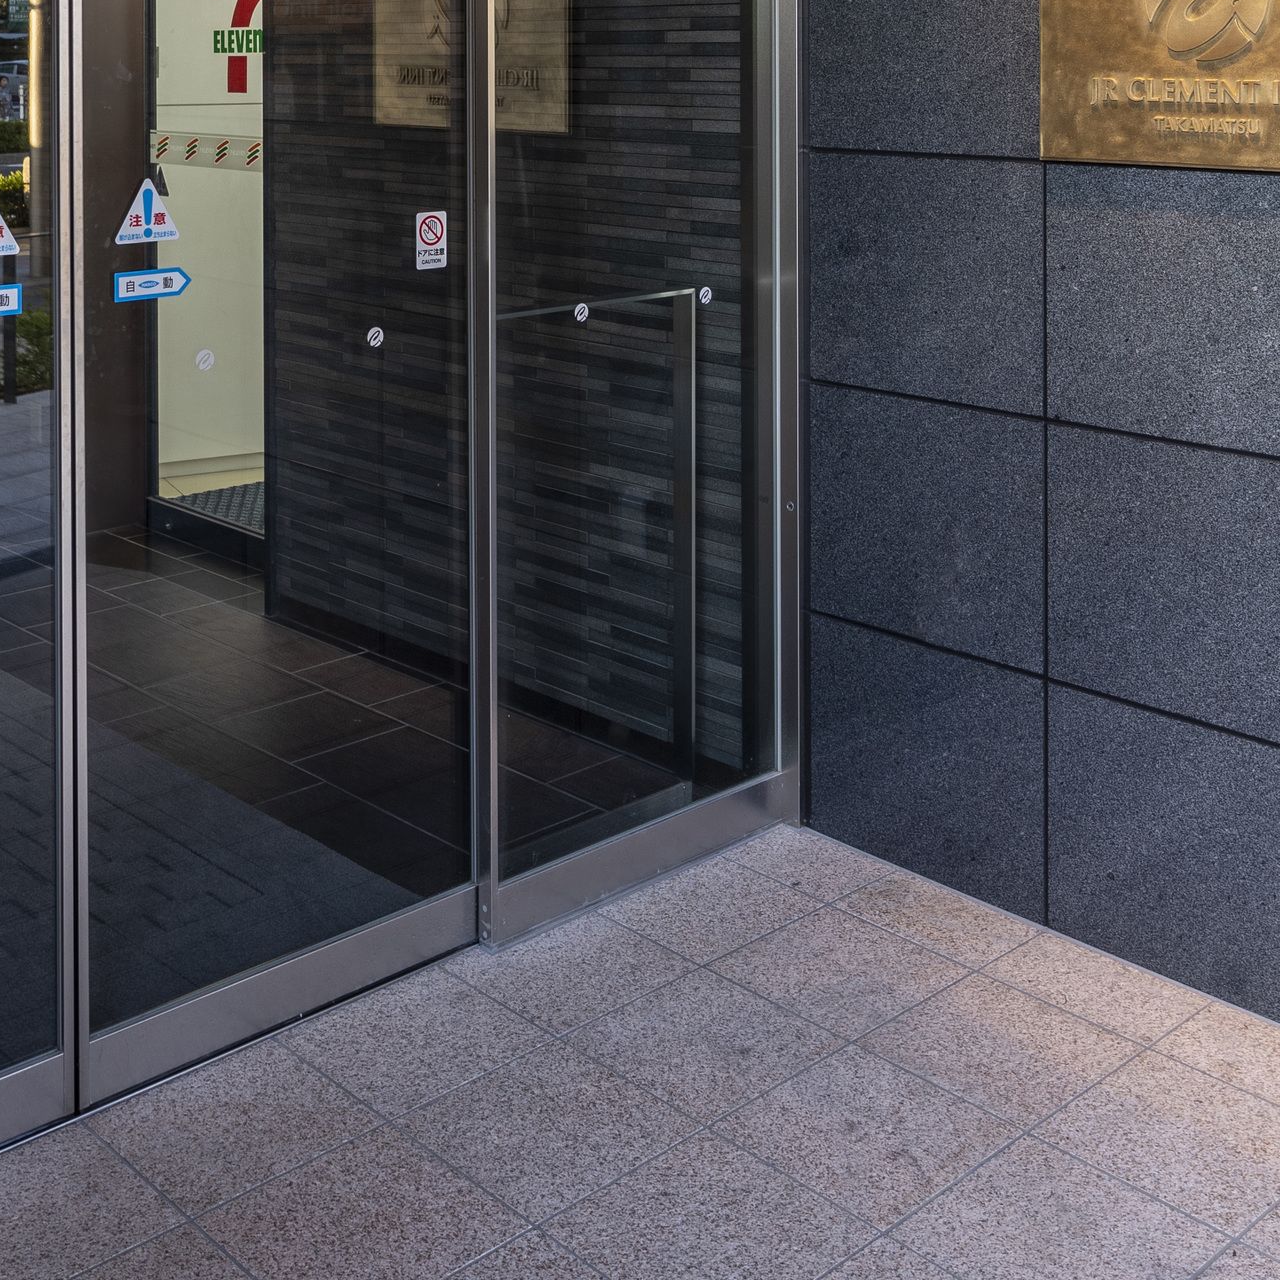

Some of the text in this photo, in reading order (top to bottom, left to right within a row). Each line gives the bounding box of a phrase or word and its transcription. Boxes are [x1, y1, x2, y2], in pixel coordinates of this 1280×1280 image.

[1090, 77, 1119, 105] JR
[1126, 77, 1261, 104] CLEMENT
[1153, 116, 1261, 135] TAKAMATSU
[418, 247, 445, 258] ドアに注意
